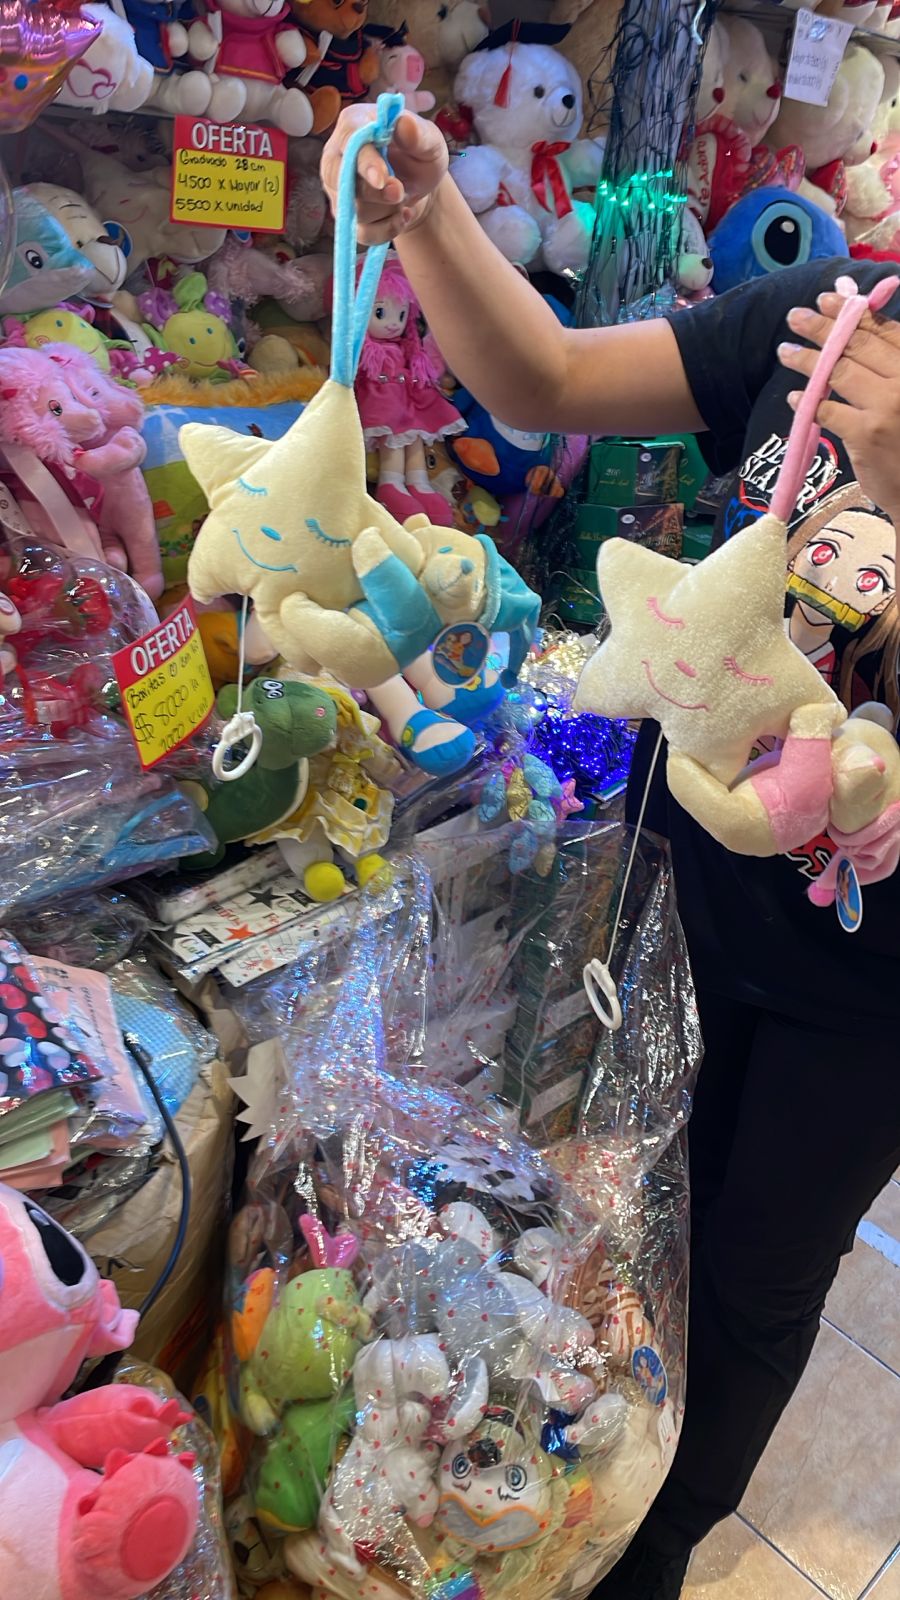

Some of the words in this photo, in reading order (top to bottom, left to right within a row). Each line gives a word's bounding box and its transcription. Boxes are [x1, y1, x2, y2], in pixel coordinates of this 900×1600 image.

[191, 122, 273, 158] OFERTA
[178, 172, 212, 190] 4500
[175, 198, 211, 212] 5500
[130, 607, 194, 676] OFERTA
